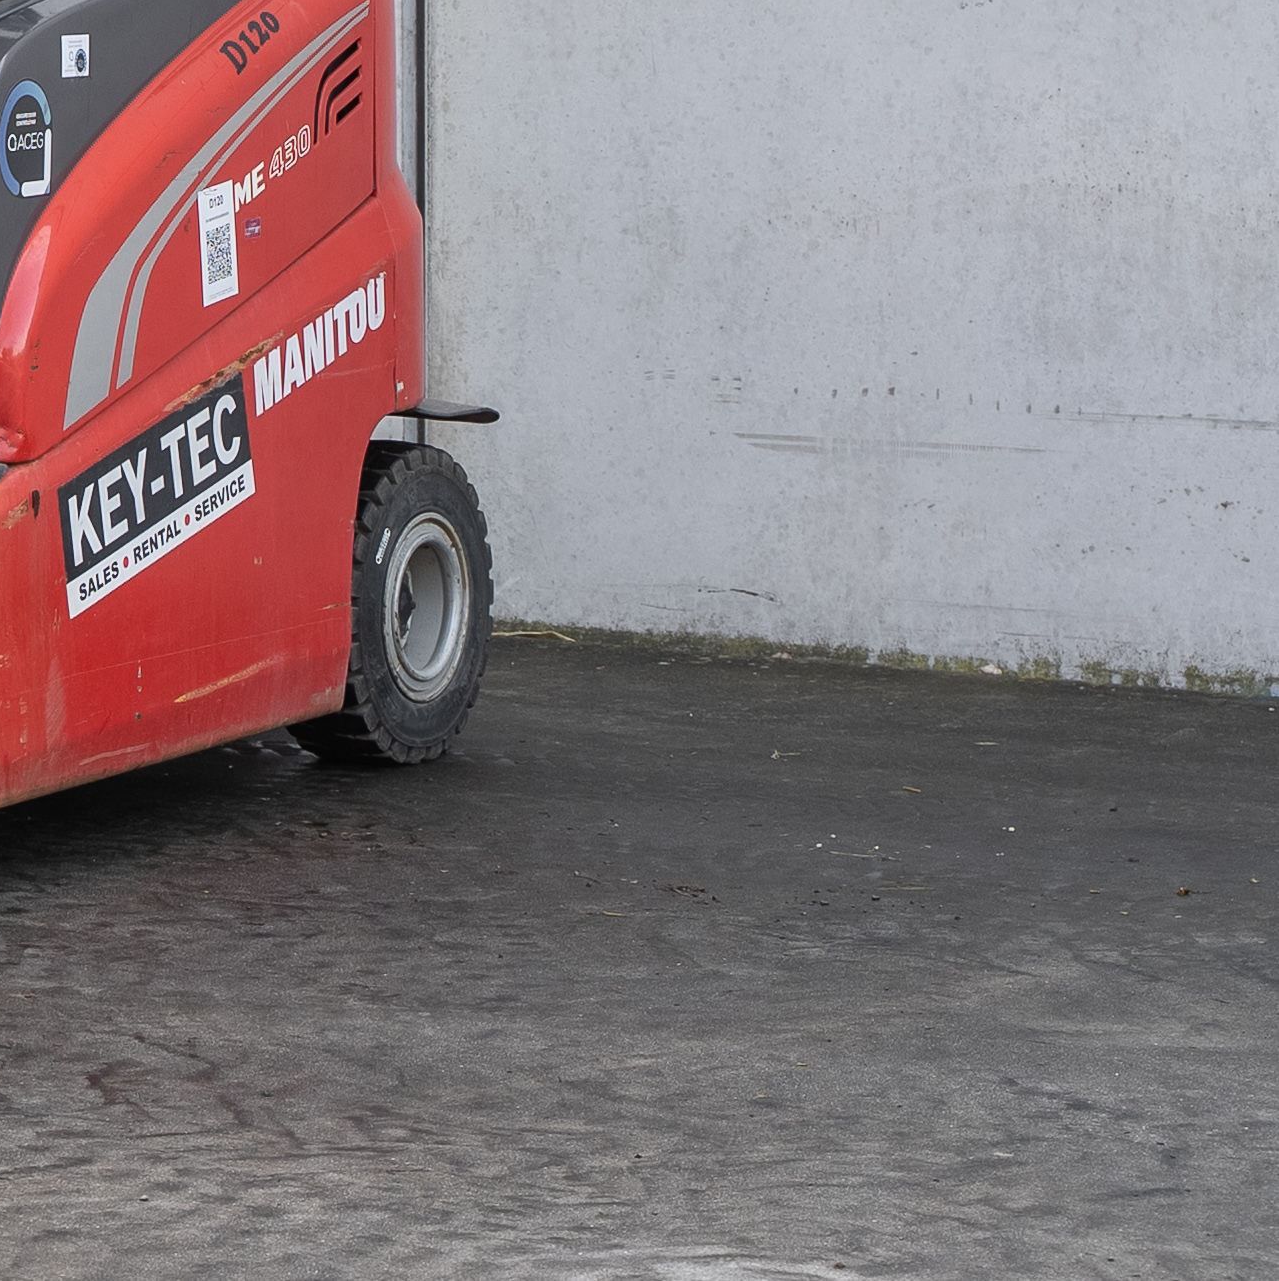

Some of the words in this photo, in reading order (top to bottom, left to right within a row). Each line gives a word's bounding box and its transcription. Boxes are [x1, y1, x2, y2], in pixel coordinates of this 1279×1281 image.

[219, 11, 280, 76] D120
[234, 161, 266, 213] ME
[268, 124, 311, 179] 430
[253, 272, 386, 417] MANITOU
[68, 394, 241, 567] KEY-TEC
[78, 561, 120, 602] SALES
[133, 520, 182, 565] RENTAL
[194, 473, 246, 522] SERVICE
